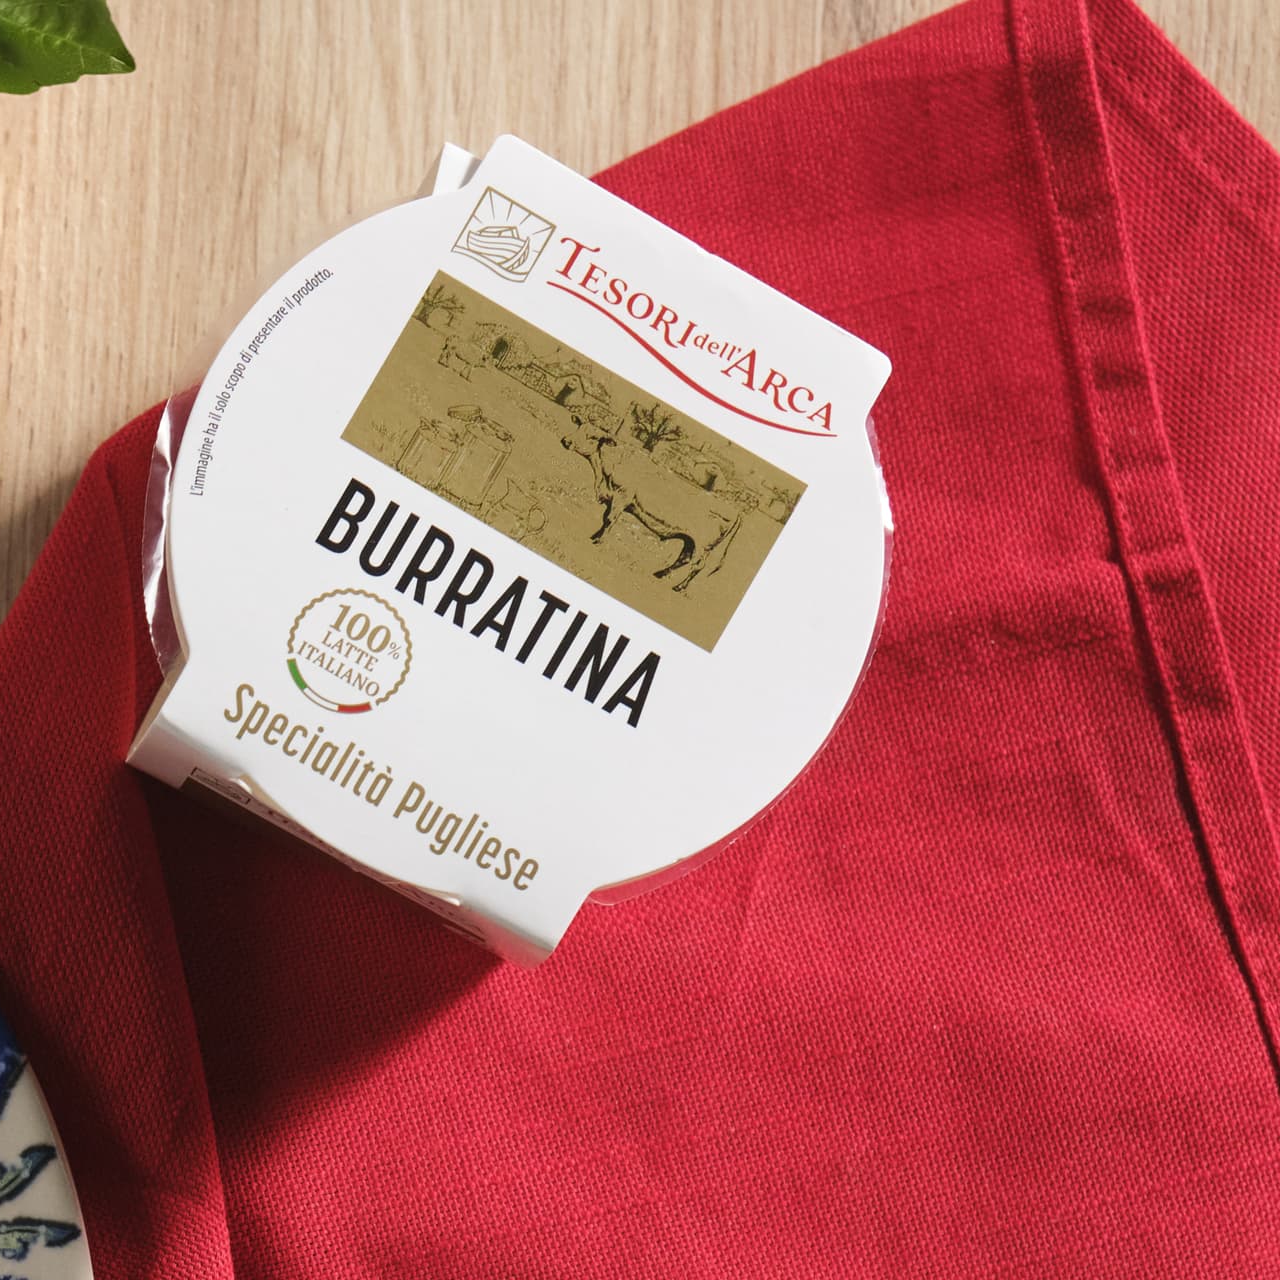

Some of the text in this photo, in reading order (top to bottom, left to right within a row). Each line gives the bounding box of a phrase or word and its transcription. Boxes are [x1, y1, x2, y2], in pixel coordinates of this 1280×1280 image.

[556, 237, 697, 348] TESORI
[190, 268, 334, 496] L'immagine ha il solo scopo di presentare il prodotto.
[315, 478, 663, 728] BURRATINA
[321, 631, 378, 672] LATTE
[329, 604, 402, 660] 100%
[297, 640, 380, 696] ITALIANO
[224, 683, 394, 808] Specialità
[393, 781, 539, 891] Pugliese
